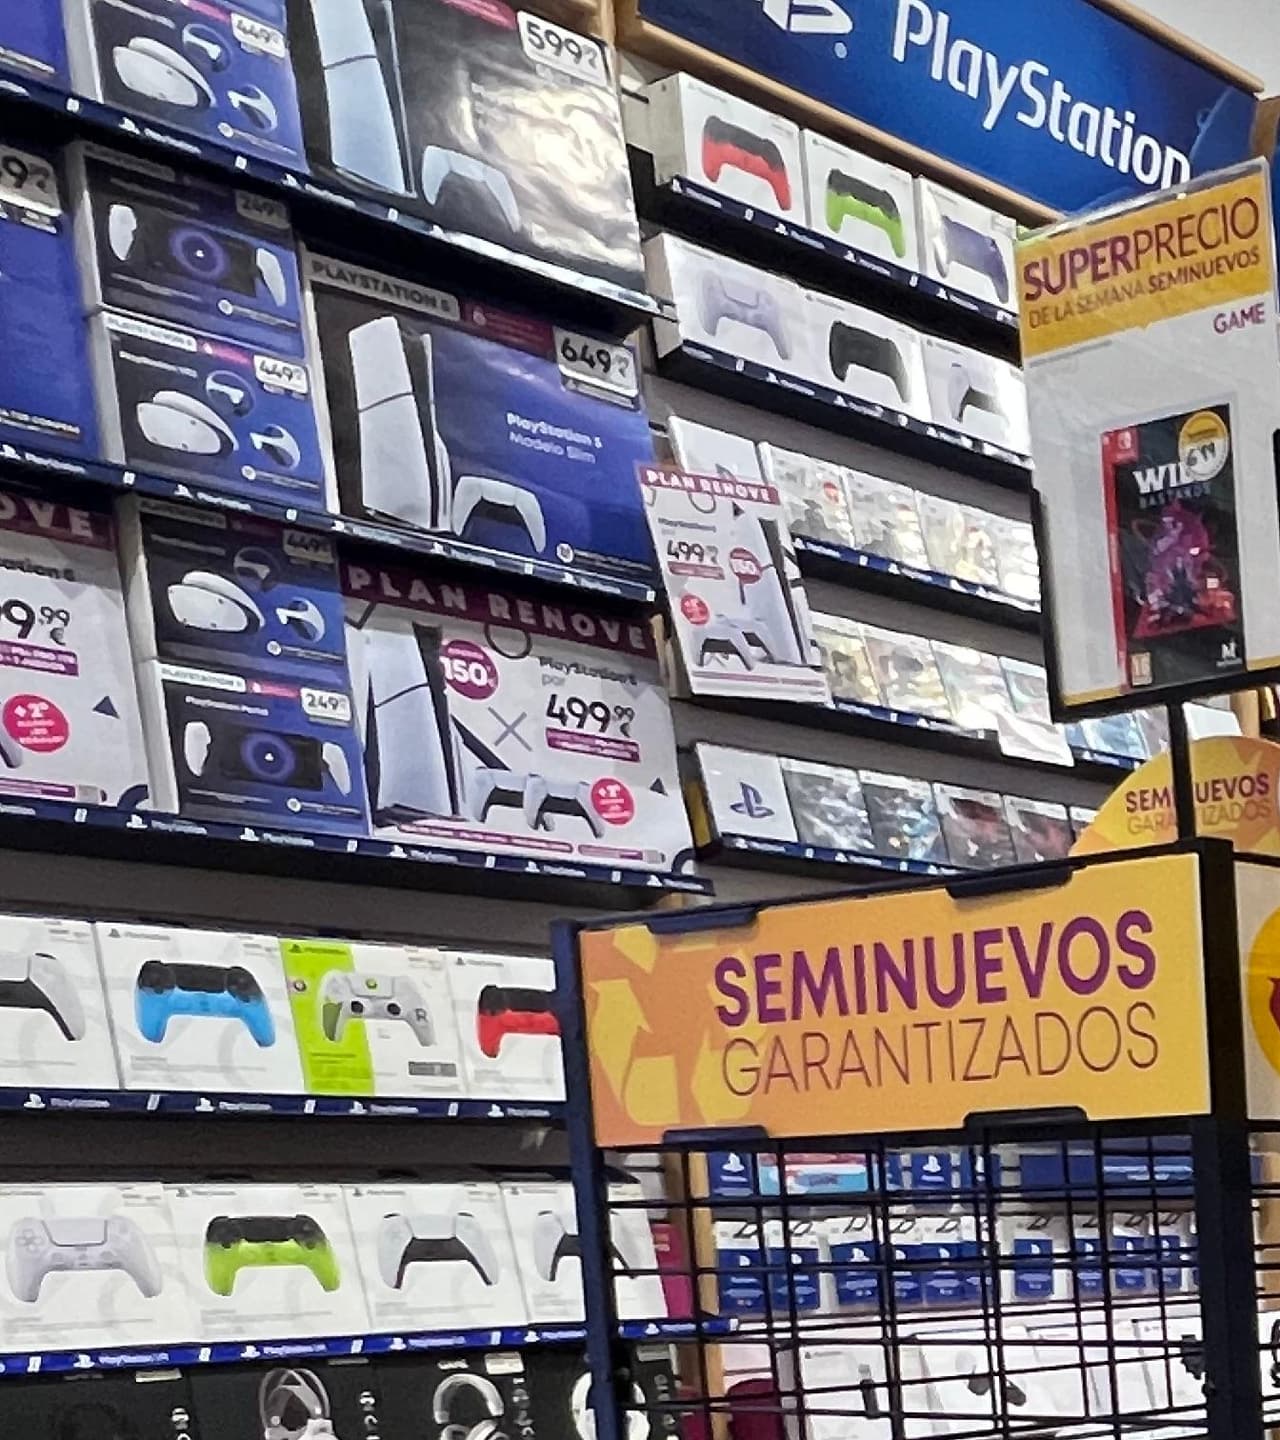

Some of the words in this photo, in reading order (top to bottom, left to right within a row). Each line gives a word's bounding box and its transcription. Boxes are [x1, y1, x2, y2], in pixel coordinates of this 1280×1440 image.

[893, 0, 1191, 191] PlayStation
[1023, 197, 1260, 301] SUPERPRECIO
[311, 259, 437, 309] PLAYSTATION
[1029, 307, 1050, 329] DE
[1054, 301, 1074, 321] LA
[1076, 281, 1149, 315] SEMANA
[1149, 245, 1260, 292] SEMINUEVOS
[1213, 302, 1266, 335] GAME
[506, 412, 592, 445] PlayStation
[510, 431, 564, 457] Modelo
[646, 470, 695, 492] PLAN
[702, 478, 770, 502] RENOVE
[1132, 461, 1195, 494] WIL
[349, 568, 467, 612] PLAN
[487, 593, 647, 650] RENOVE
[1125, 773, 1270, 813] SEMUEVOS
[1127, 799, 1273, 834] GARAIZADOS
[714, 909, 1156, 1027] SEMINUEVOS
[722, 1001, 1159, 1097] GARANTIZADOS
